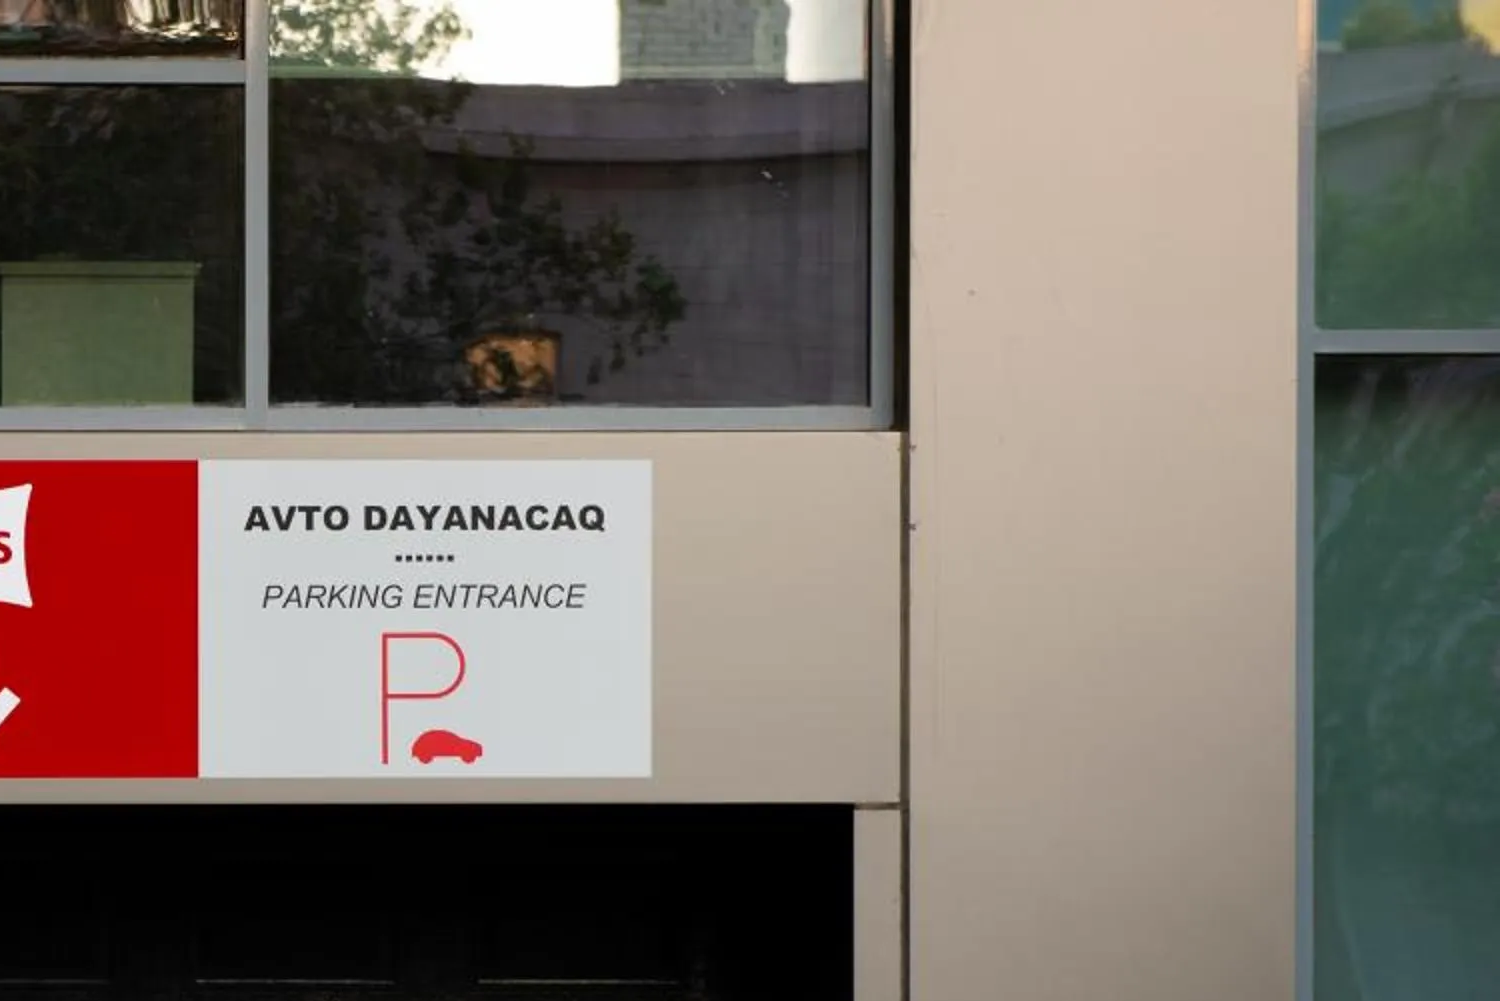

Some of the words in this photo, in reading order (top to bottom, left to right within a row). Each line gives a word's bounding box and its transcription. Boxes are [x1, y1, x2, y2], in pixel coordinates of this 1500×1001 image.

[243, 505, 350, 532] AVTO
[363, 504, 606, 532] DAYANACAQ
[262, 583, 404, 609] PARKING
[412, 583, 587, 609] ENTRANCE
[380, 631, 466, 764] P
